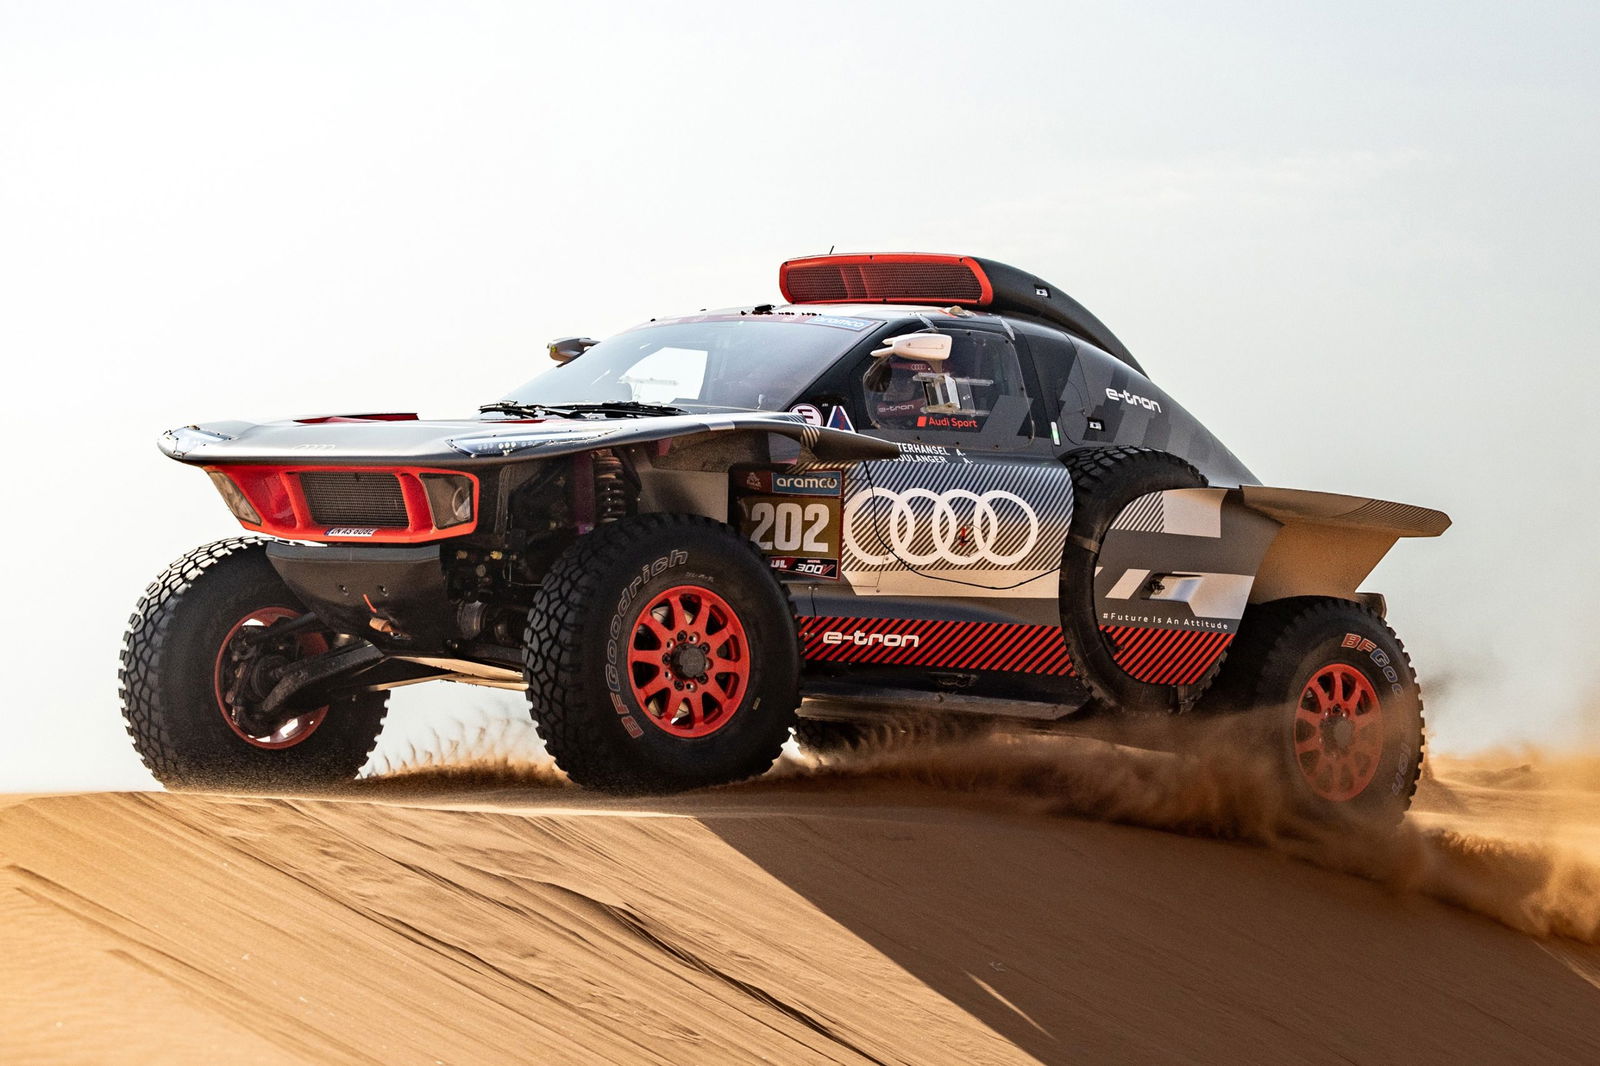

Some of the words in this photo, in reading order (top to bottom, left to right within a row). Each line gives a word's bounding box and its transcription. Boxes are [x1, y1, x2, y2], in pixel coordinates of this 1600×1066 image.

[1105, 388, 1161, 413] e-tron
[929, 417, 949, 426] Audi
[951, 418, 977, 428] Sport
[897, 443, 950, 455] TERHANSEL
[776, 478, 838, 489] aramco
[750, 502, 830, 553] 202
[1103, 612, 1148, 623] #Future
[1153, 616, 1162, 624] Is
[1166, 617, 1179, 625] An
[1183, 618, 1228, 630] Attitude
[605, 550, 688, 738] BFGoodrich
[823, 630, 920, 648] e-tron
